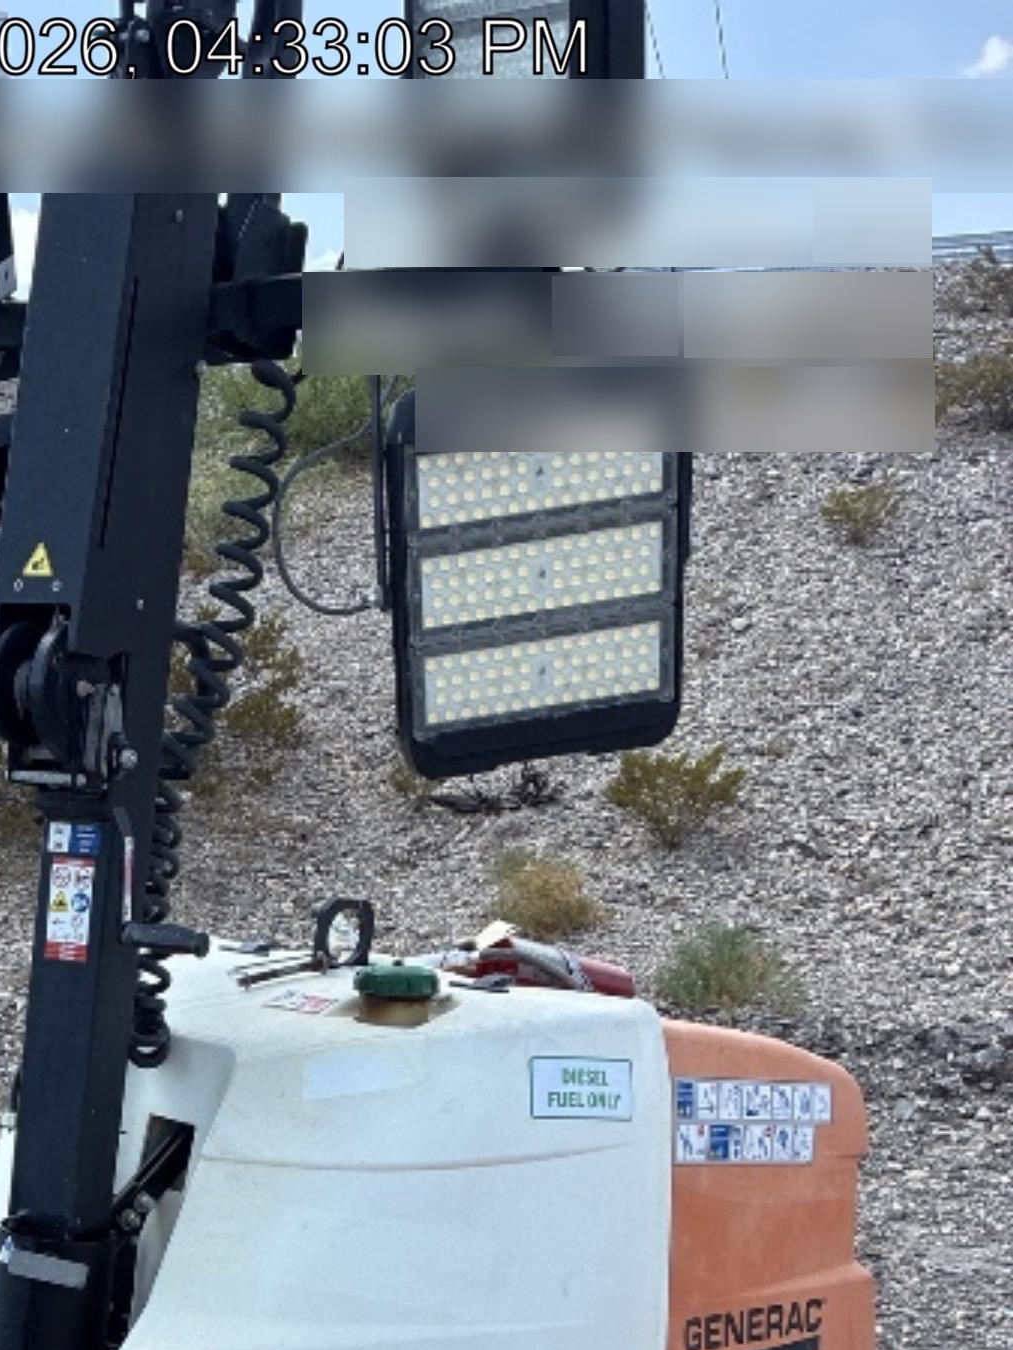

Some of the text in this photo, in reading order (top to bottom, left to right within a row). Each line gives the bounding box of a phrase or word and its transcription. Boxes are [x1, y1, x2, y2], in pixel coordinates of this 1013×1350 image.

[561, 1067, 609, 1087] DIESEL
[547, 1091, 621, 1110] FUEL ONLY
